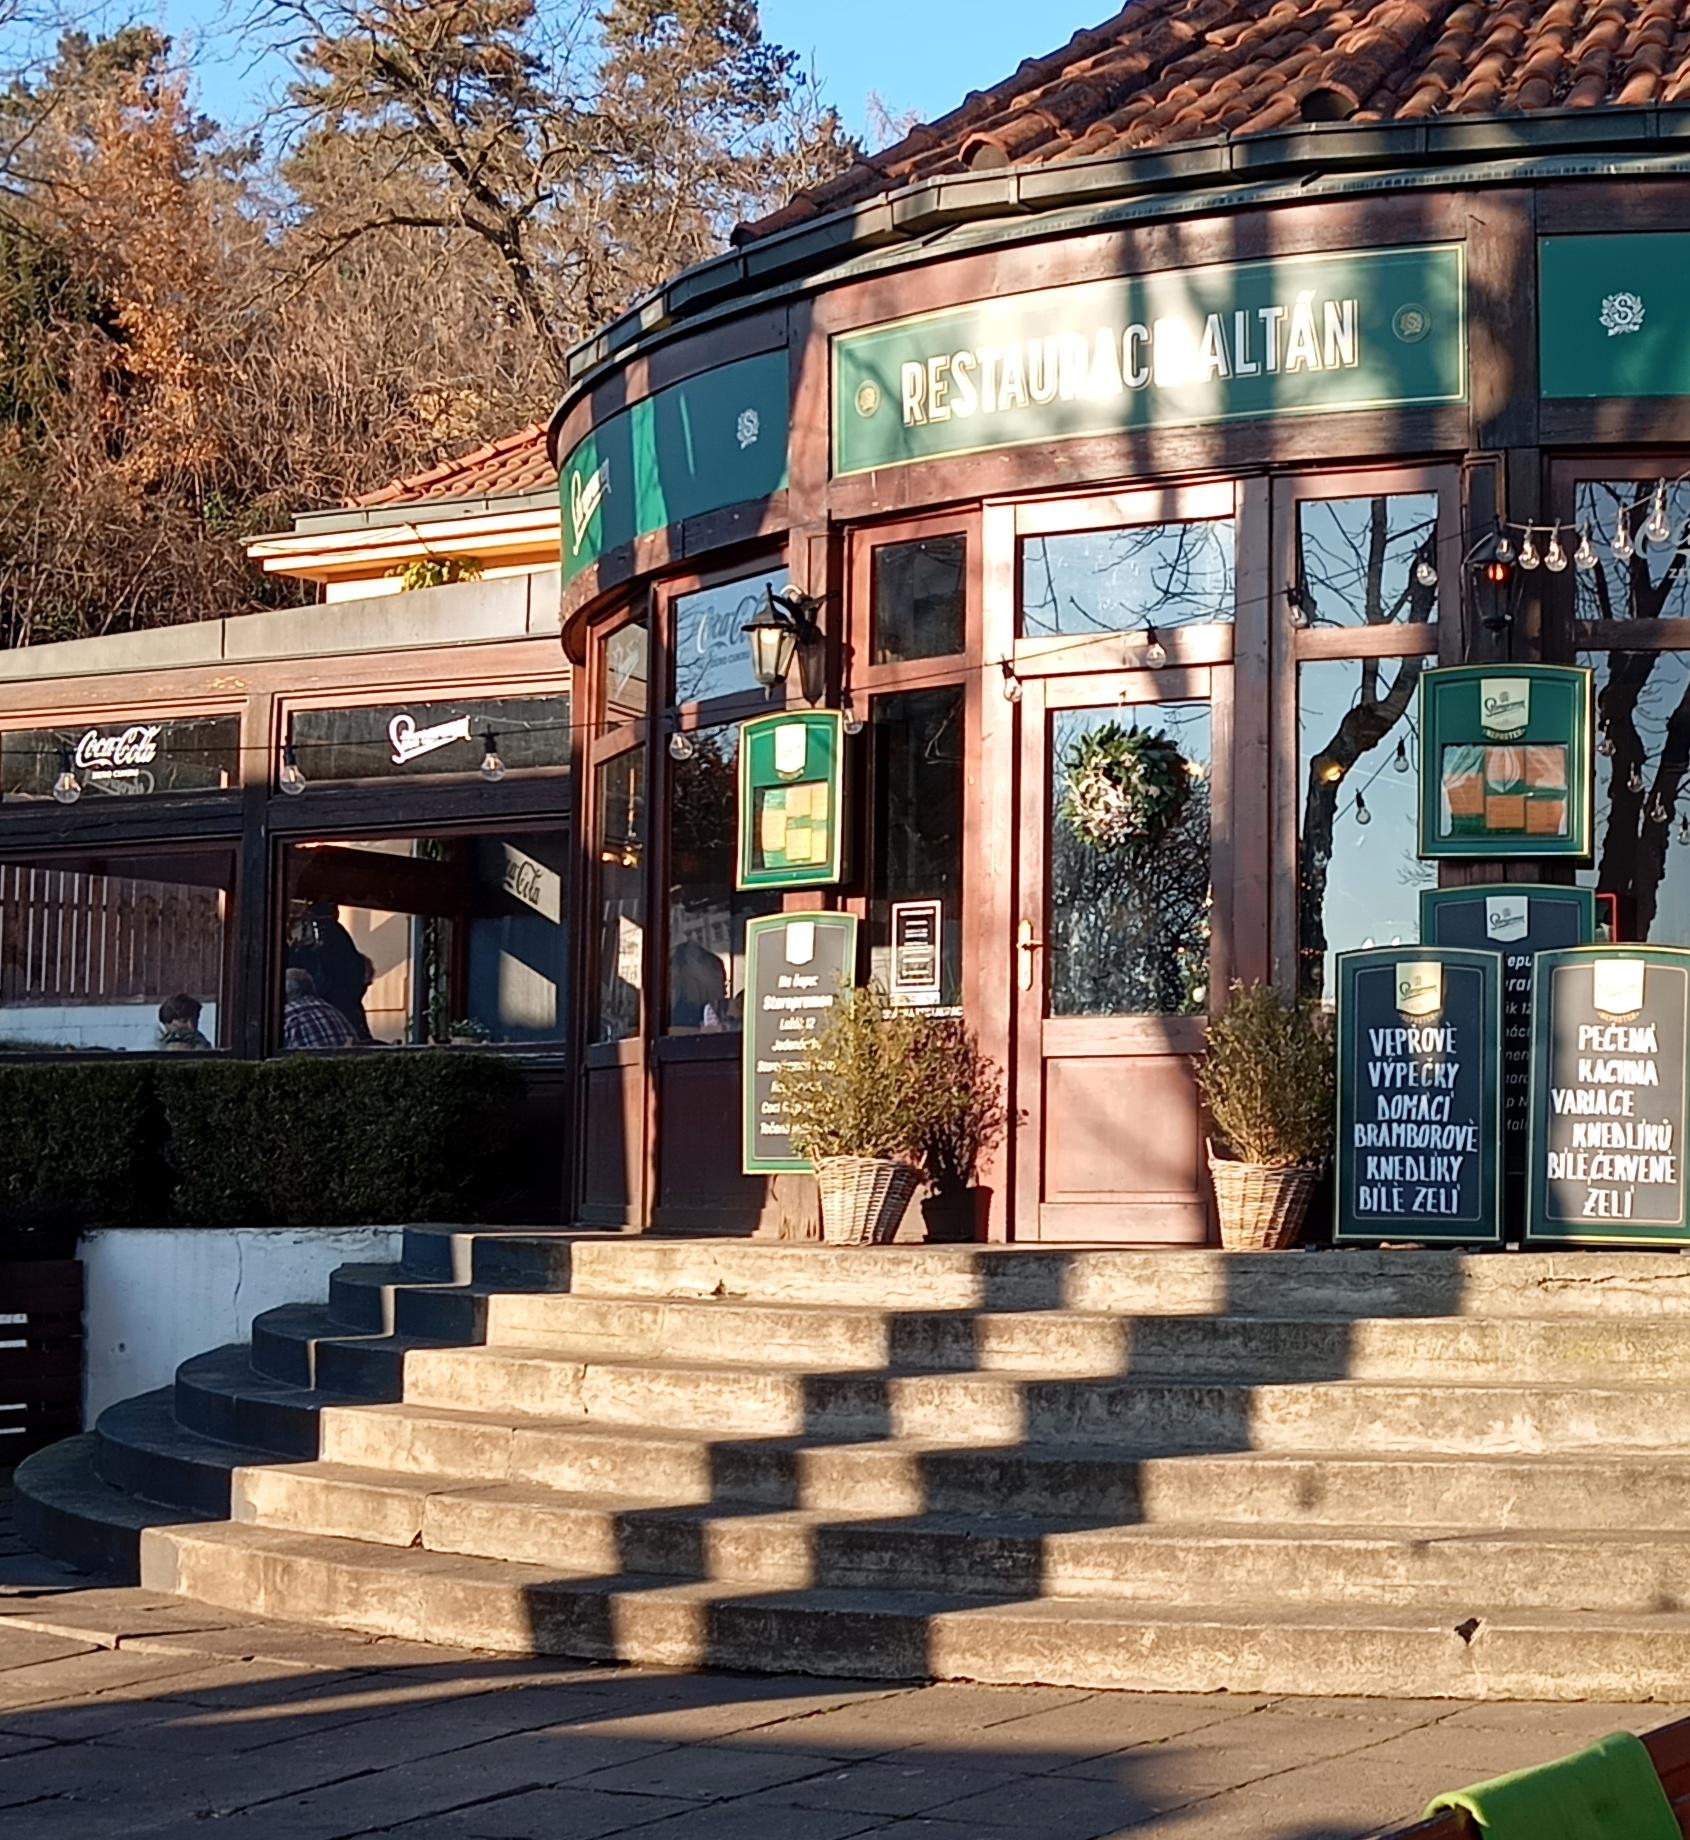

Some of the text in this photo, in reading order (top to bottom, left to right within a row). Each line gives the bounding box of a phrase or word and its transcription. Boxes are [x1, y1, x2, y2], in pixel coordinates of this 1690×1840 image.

[901, 290, 1358, 427] RESTAURAC ALTÁN
[75, 725, 162, 768] Coca-Cola
[1578, 1059, 1659, 1087] KACHNA
[1551, 1088, 1635, 1118] VARIACE
